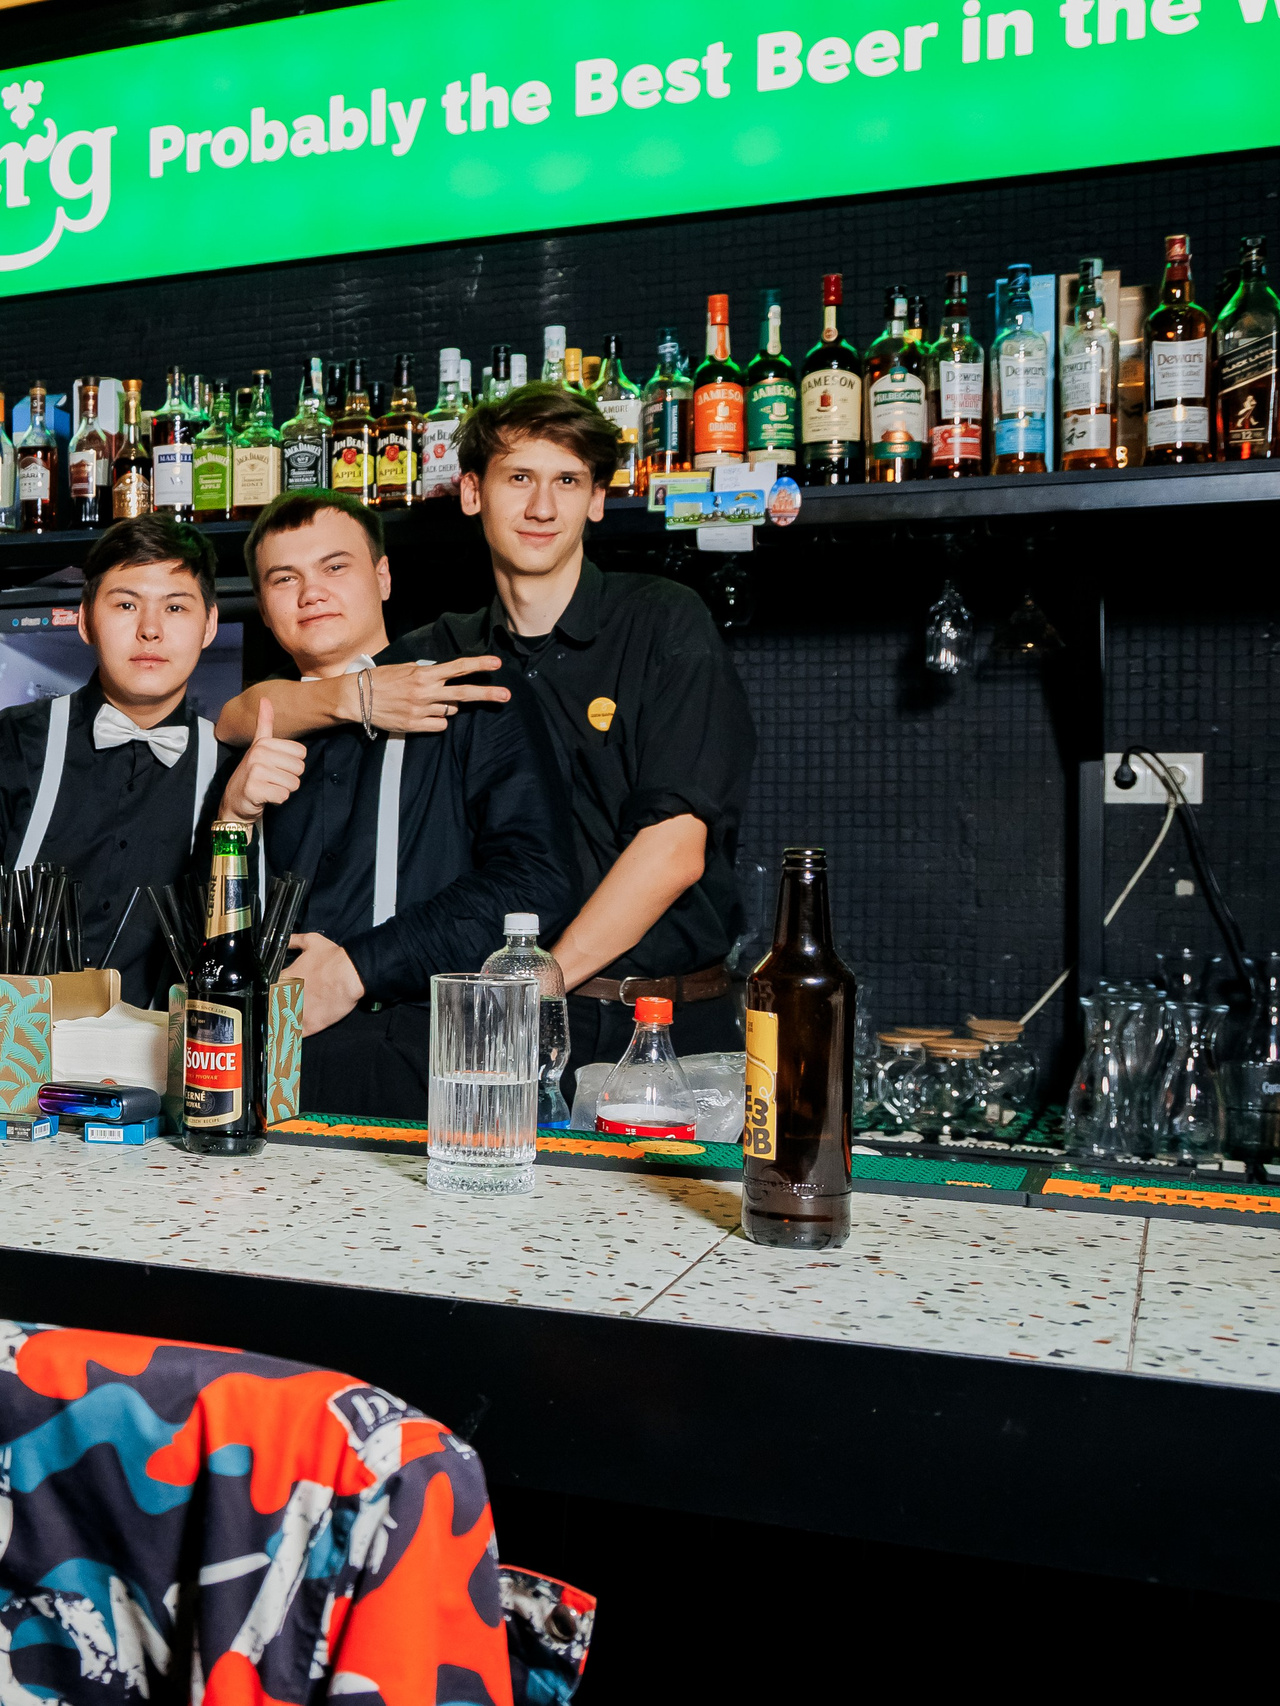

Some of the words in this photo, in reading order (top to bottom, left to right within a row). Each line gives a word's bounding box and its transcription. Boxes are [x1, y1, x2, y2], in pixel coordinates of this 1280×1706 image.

[149, 94, 426, 179] Probably
[441, 72, 551, 135] the
[575, 41, 731, 118] Best
[756, 24, 938, 93] Beer
[961, 0, 1034, 64] in
[1059, 0, 1203, 49] the
[803, 375, 856, 394] JAMESON
[875, 391, 920, 402] KILBEGGAN
[708, 422, 737, 432] ORANGE
[284, 444, 299, 458] JACK
[333, 439, 347, 454] JIM
[185, 1046, 236, 1071] ŠOVICE
